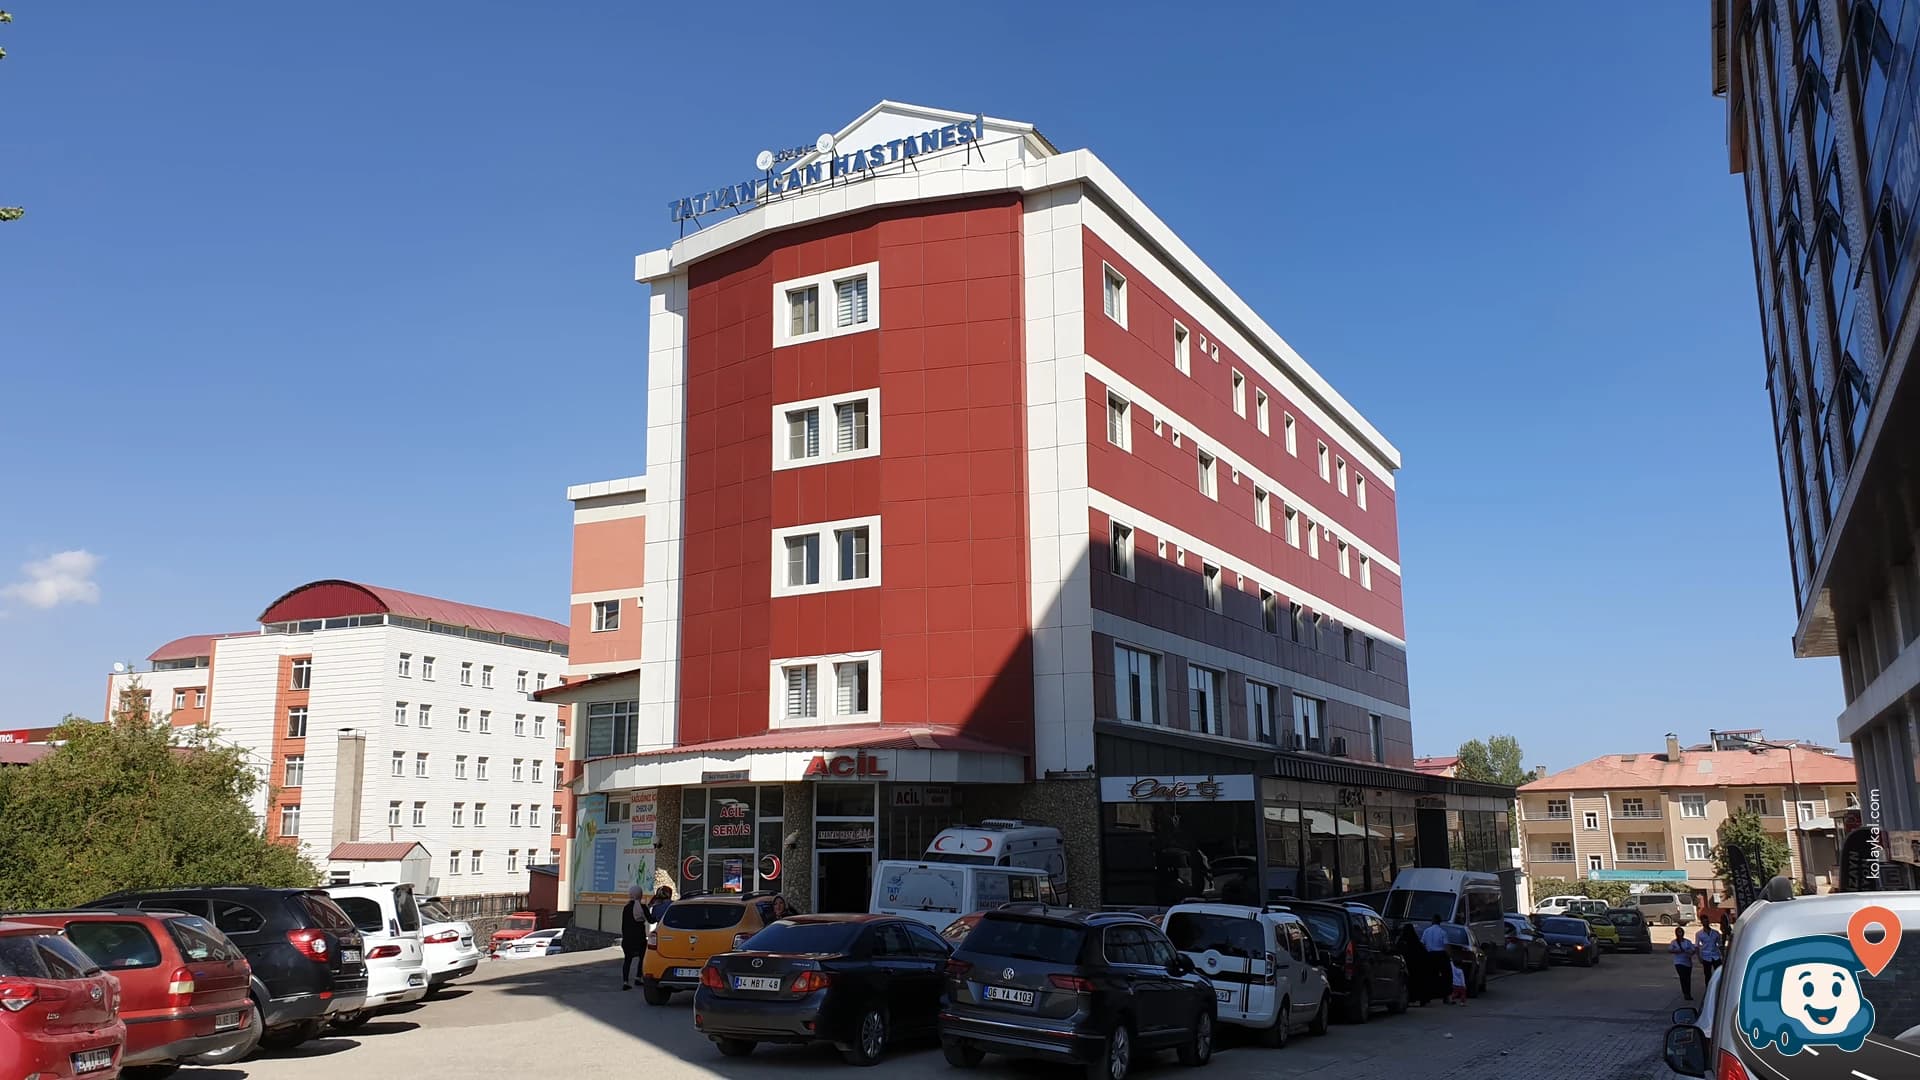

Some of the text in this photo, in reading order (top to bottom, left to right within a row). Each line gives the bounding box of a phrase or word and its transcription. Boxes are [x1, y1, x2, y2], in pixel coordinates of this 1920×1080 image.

[668, 112, 984, 222] TATVAN CAN HASTANESİ
[0, 733, 14, 743] TROL
[803, 751, 888, 777] ACİL
[896, 788, 920, 804] ACİL
[719, 804, 745, 818] ACİL
[712, 820, 751, 836] SERVİS
[750, 978, 765, 988] MBT
[989, 988, 997, 997] 06
[1014, 992, 1032, 1002] 4103
